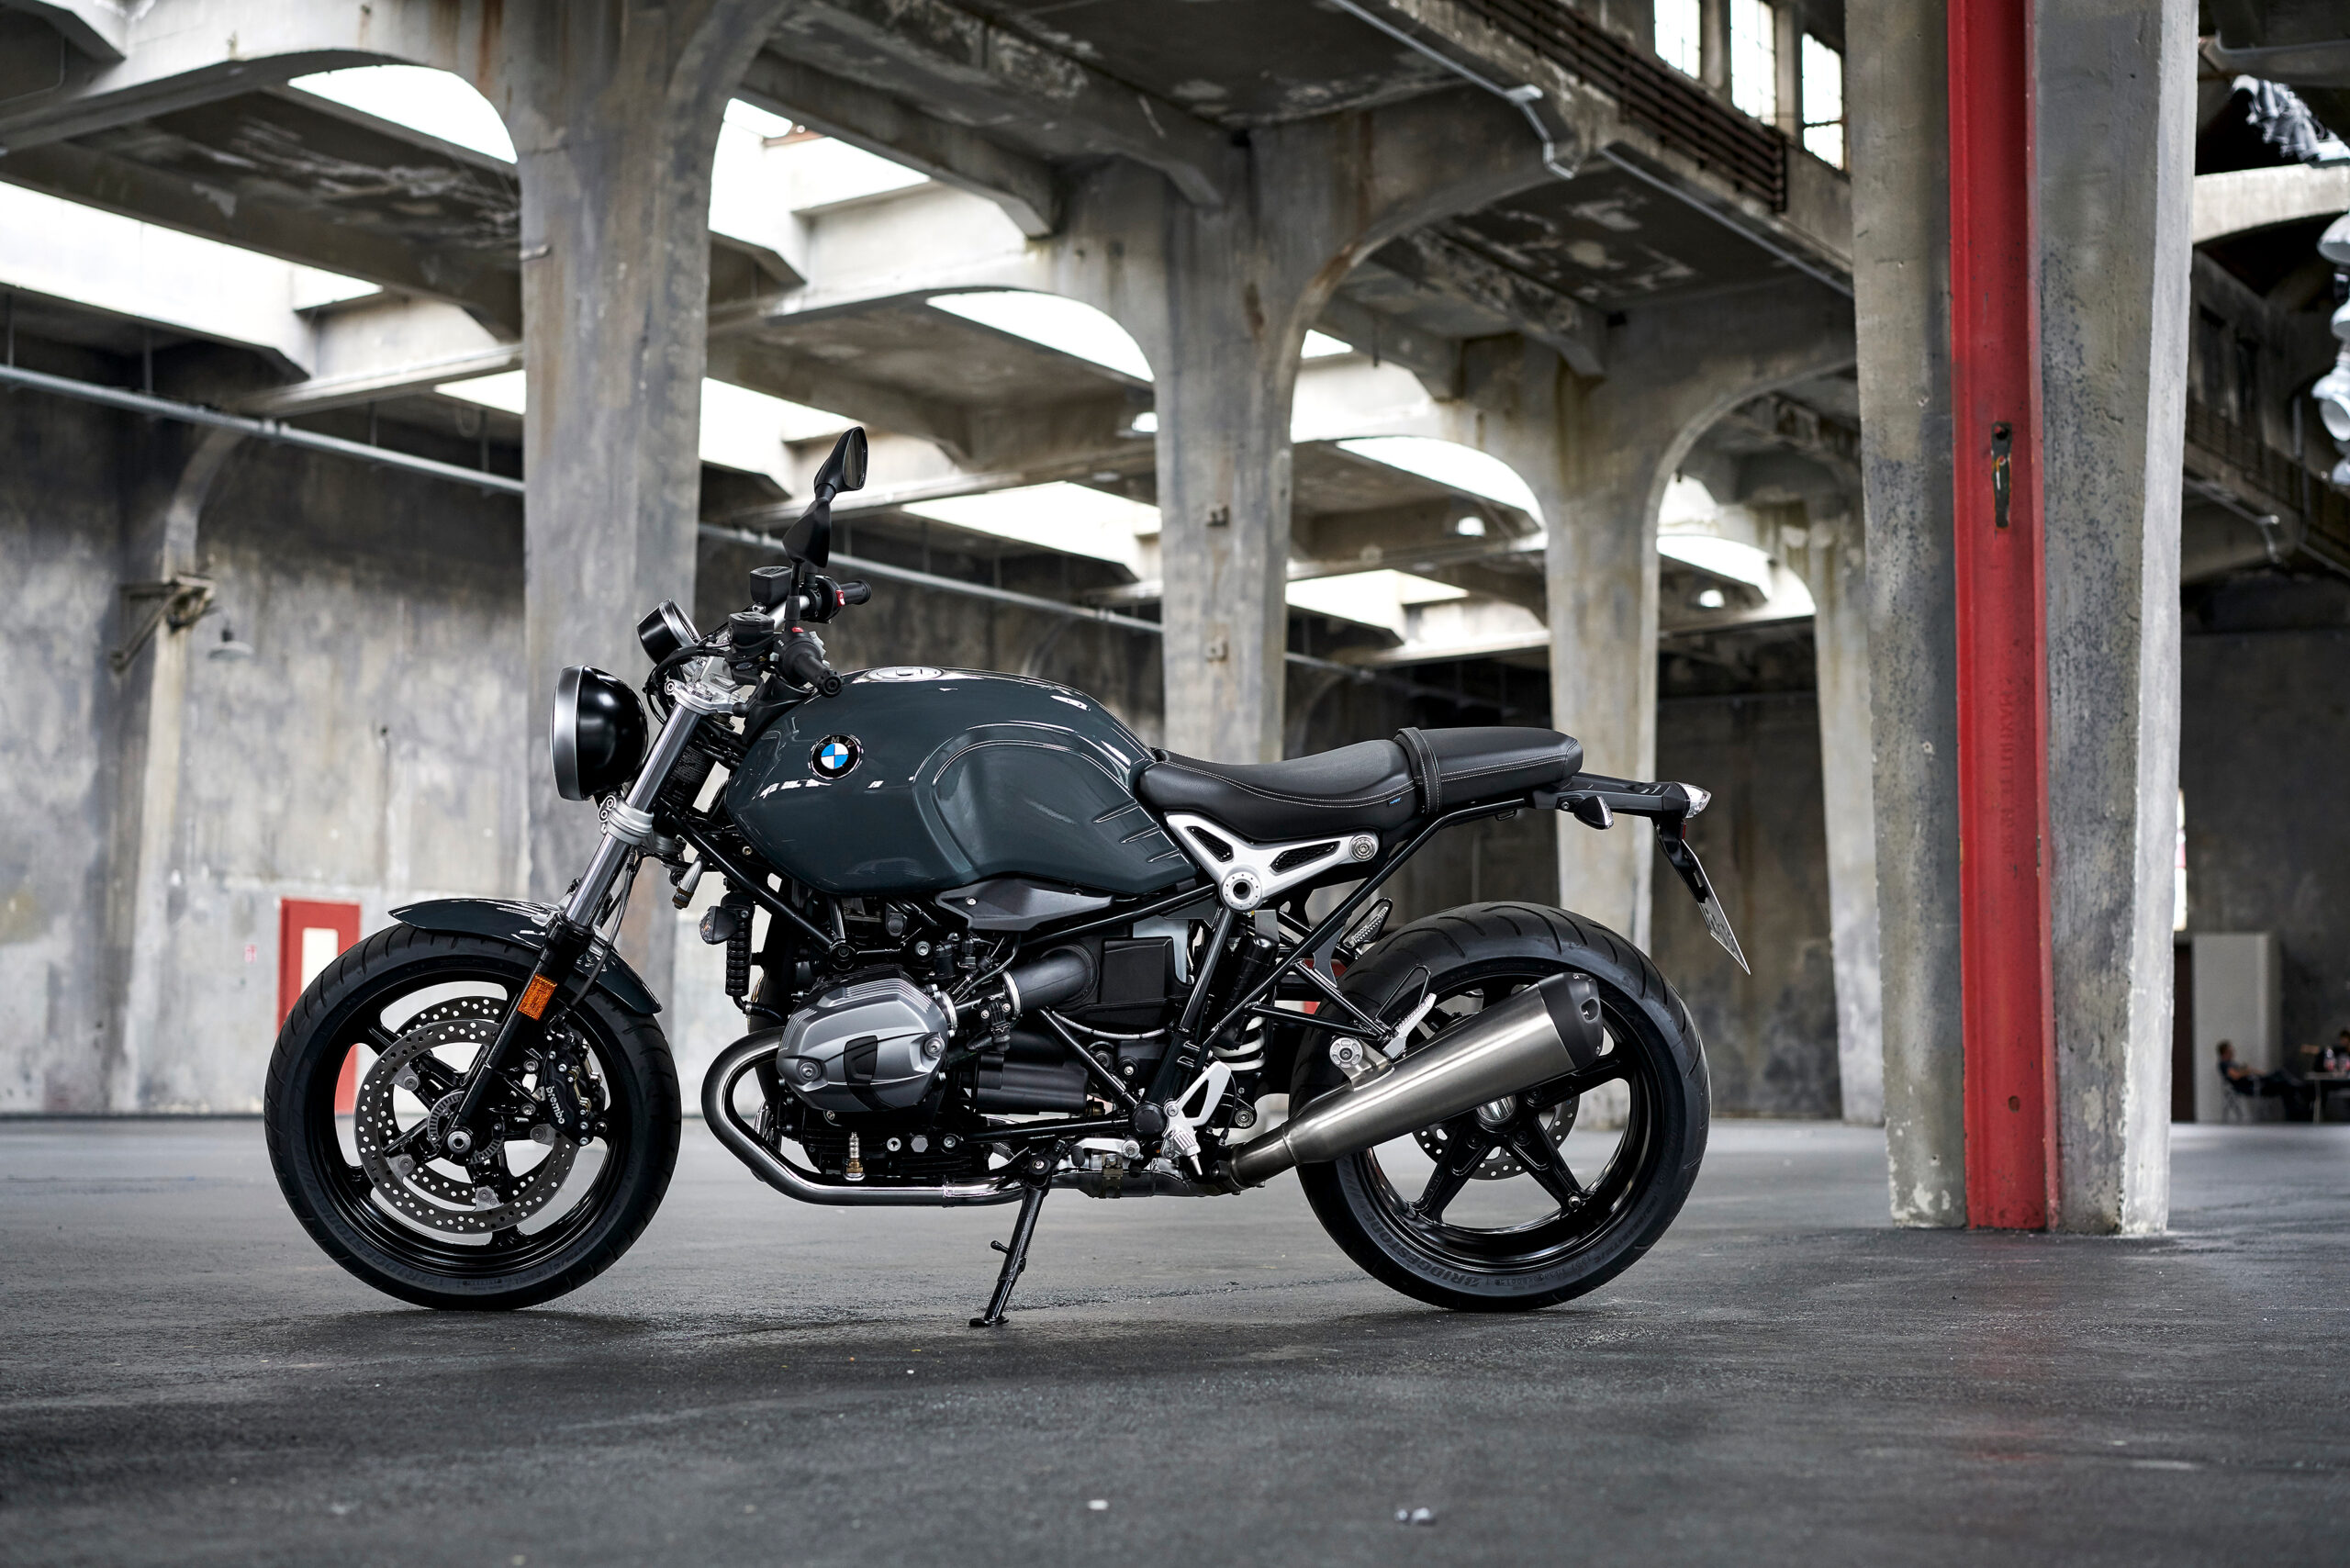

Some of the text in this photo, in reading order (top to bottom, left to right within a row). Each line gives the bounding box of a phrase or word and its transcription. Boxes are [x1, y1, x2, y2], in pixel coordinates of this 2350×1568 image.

[817, 736, 855, 751] BMW
[545, 1085, 565, 1125] brembo
[1362, 1211, 1483, 1287] BRIDGESTONE
